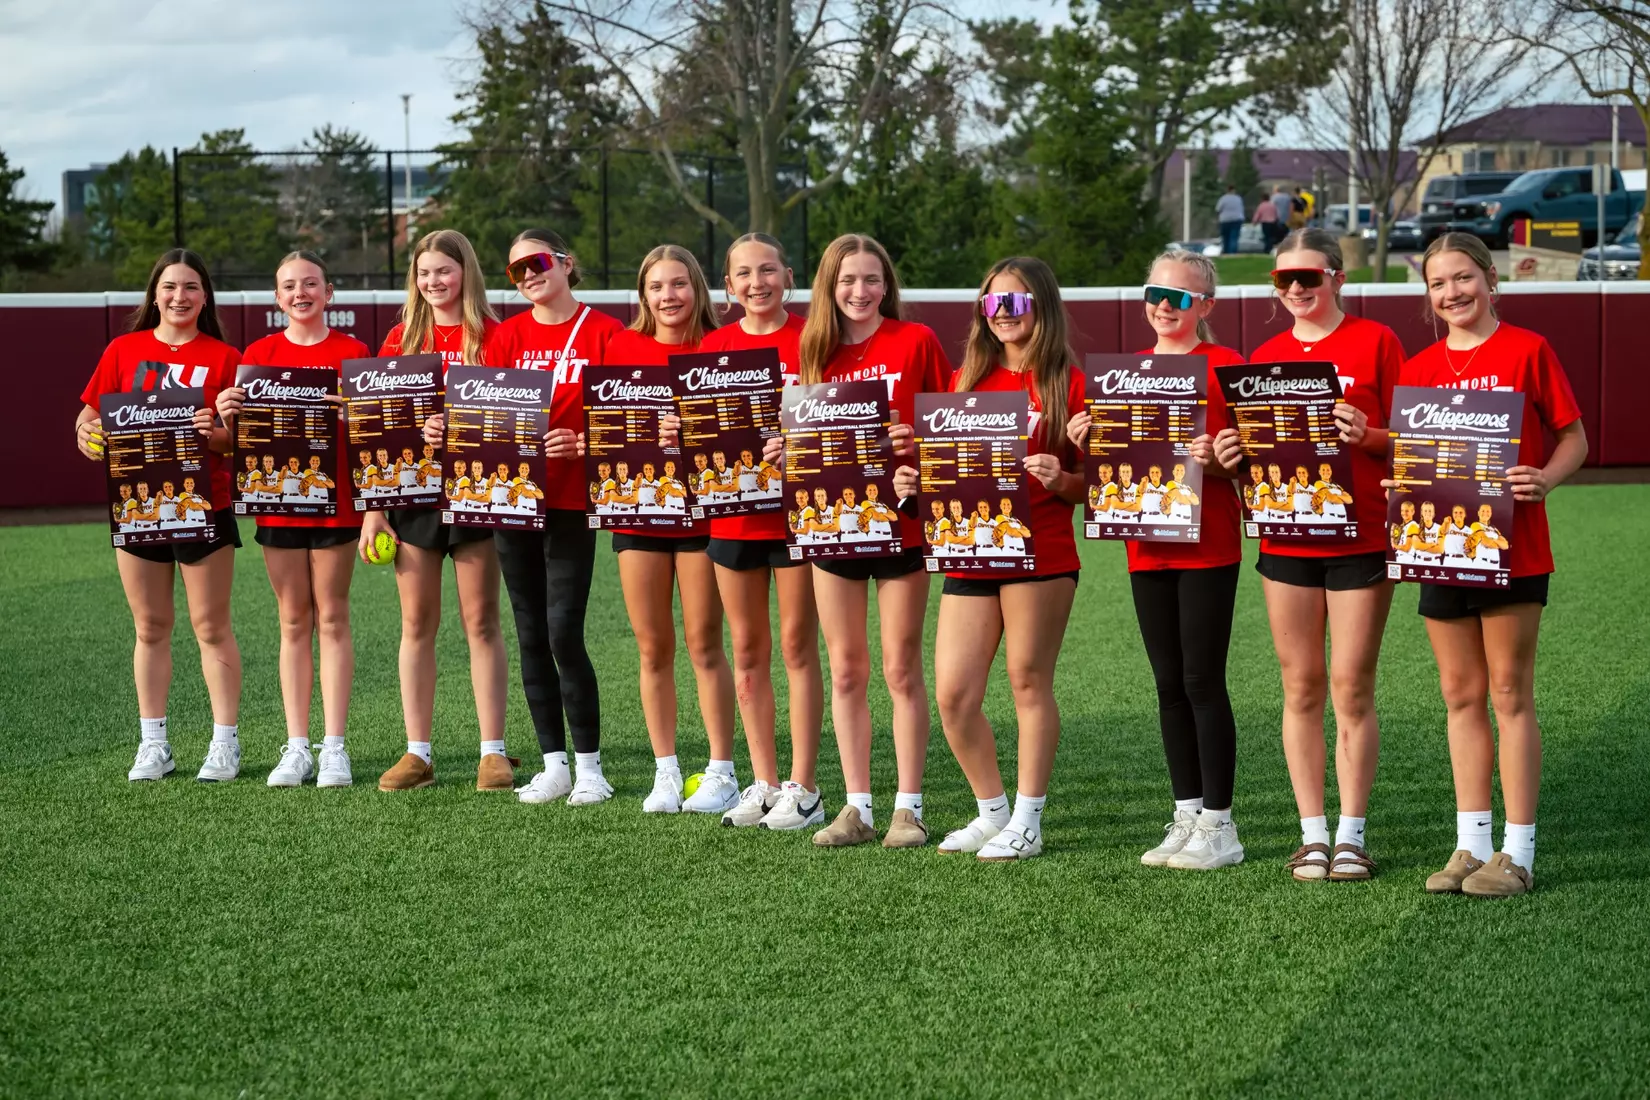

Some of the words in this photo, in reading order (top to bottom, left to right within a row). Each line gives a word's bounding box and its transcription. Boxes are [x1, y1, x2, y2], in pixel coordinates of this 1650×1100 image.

[265, 311, 290, 328] 198
[523, 349, 577, 360] DIAMOD
[349, 370, 434, 392] Chippewas
[678, 367, 770, 391] Chippewas
[831, 364, 887, 383] DIAMOND
[1093, 369, 1195, 395] Chippewas
[242, 378, 328, 400] Chippewas
[454, 379, 541, 402] Chippewas
[591, 379, 674, 401] Chippewa
[1229, 376, 1329, 398] Chippewas
[108, 405, 195, 426] Chippewas
[788, 399, 878, 423] Chippewas
[922, 407, 1017, 433] Chippewas
[1400, 403, 1510, 430] Chippewas
